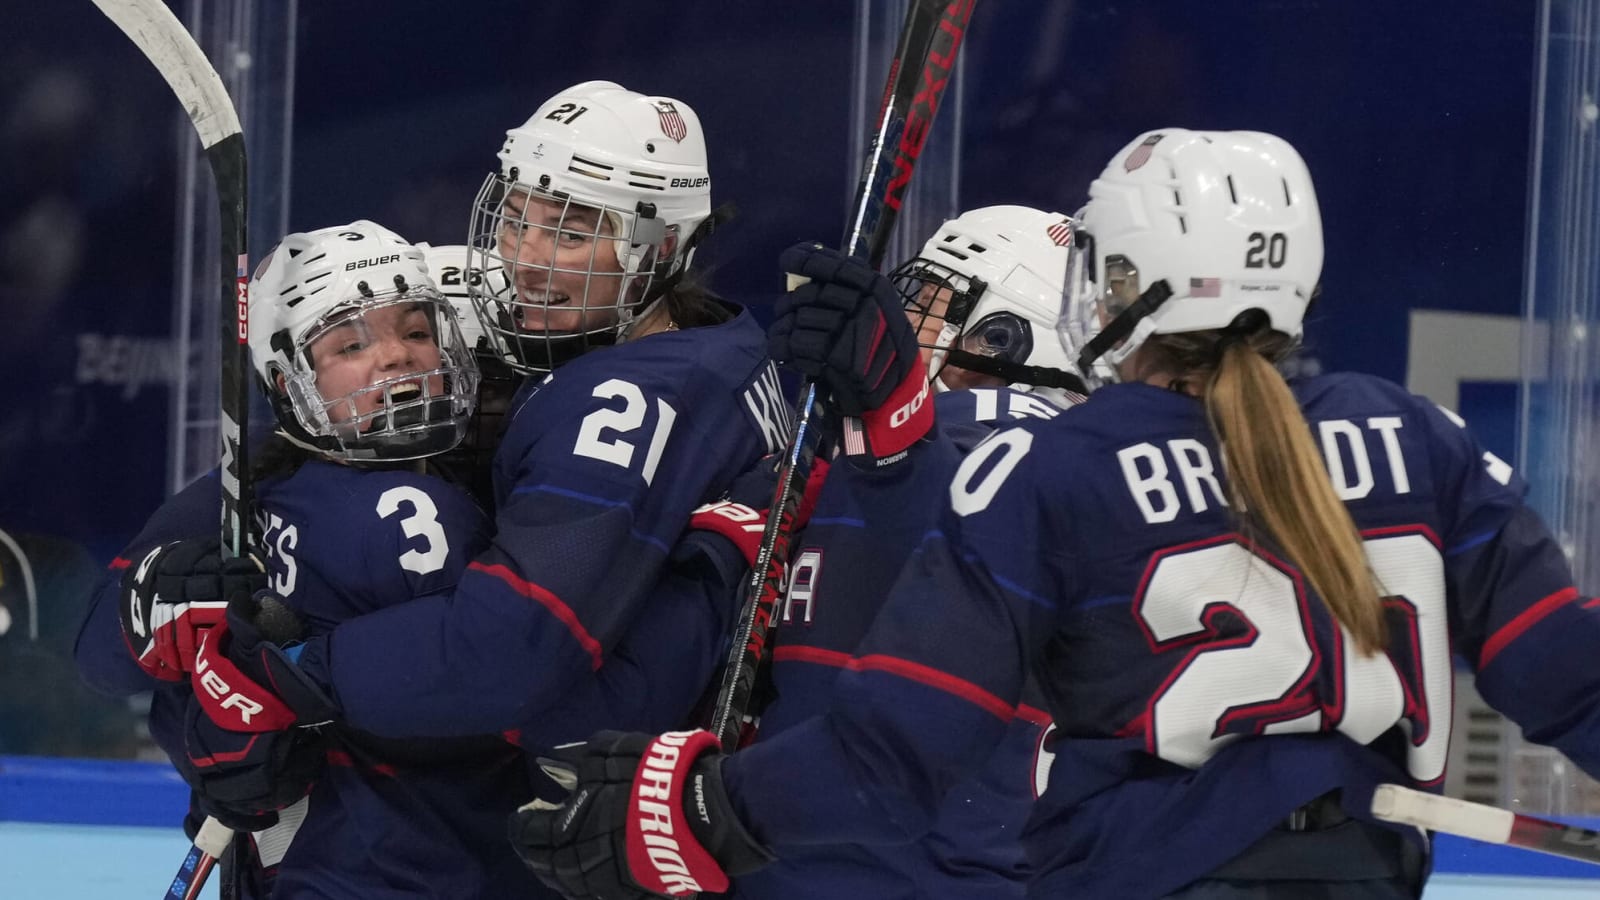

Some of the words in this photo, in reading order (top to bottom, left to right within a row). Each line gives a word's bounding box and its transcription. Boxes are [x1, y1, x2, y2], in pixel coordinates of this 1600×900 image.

[545, 103, 589, 125] 21
[670, 177, 709, 188] BAUER
[338, 231, 364, 242] 3
[1244, 231, 1288, 269] 20
[345, 254, 401, 272] BAUER
[237, 283, 248, 339] CCM
[573, 378, 677, 489] 21
[1117, 416, 1411, 525] BRDT
[376, 485, 449, 575] 3
[1131, 532, 1455, 787] 20
